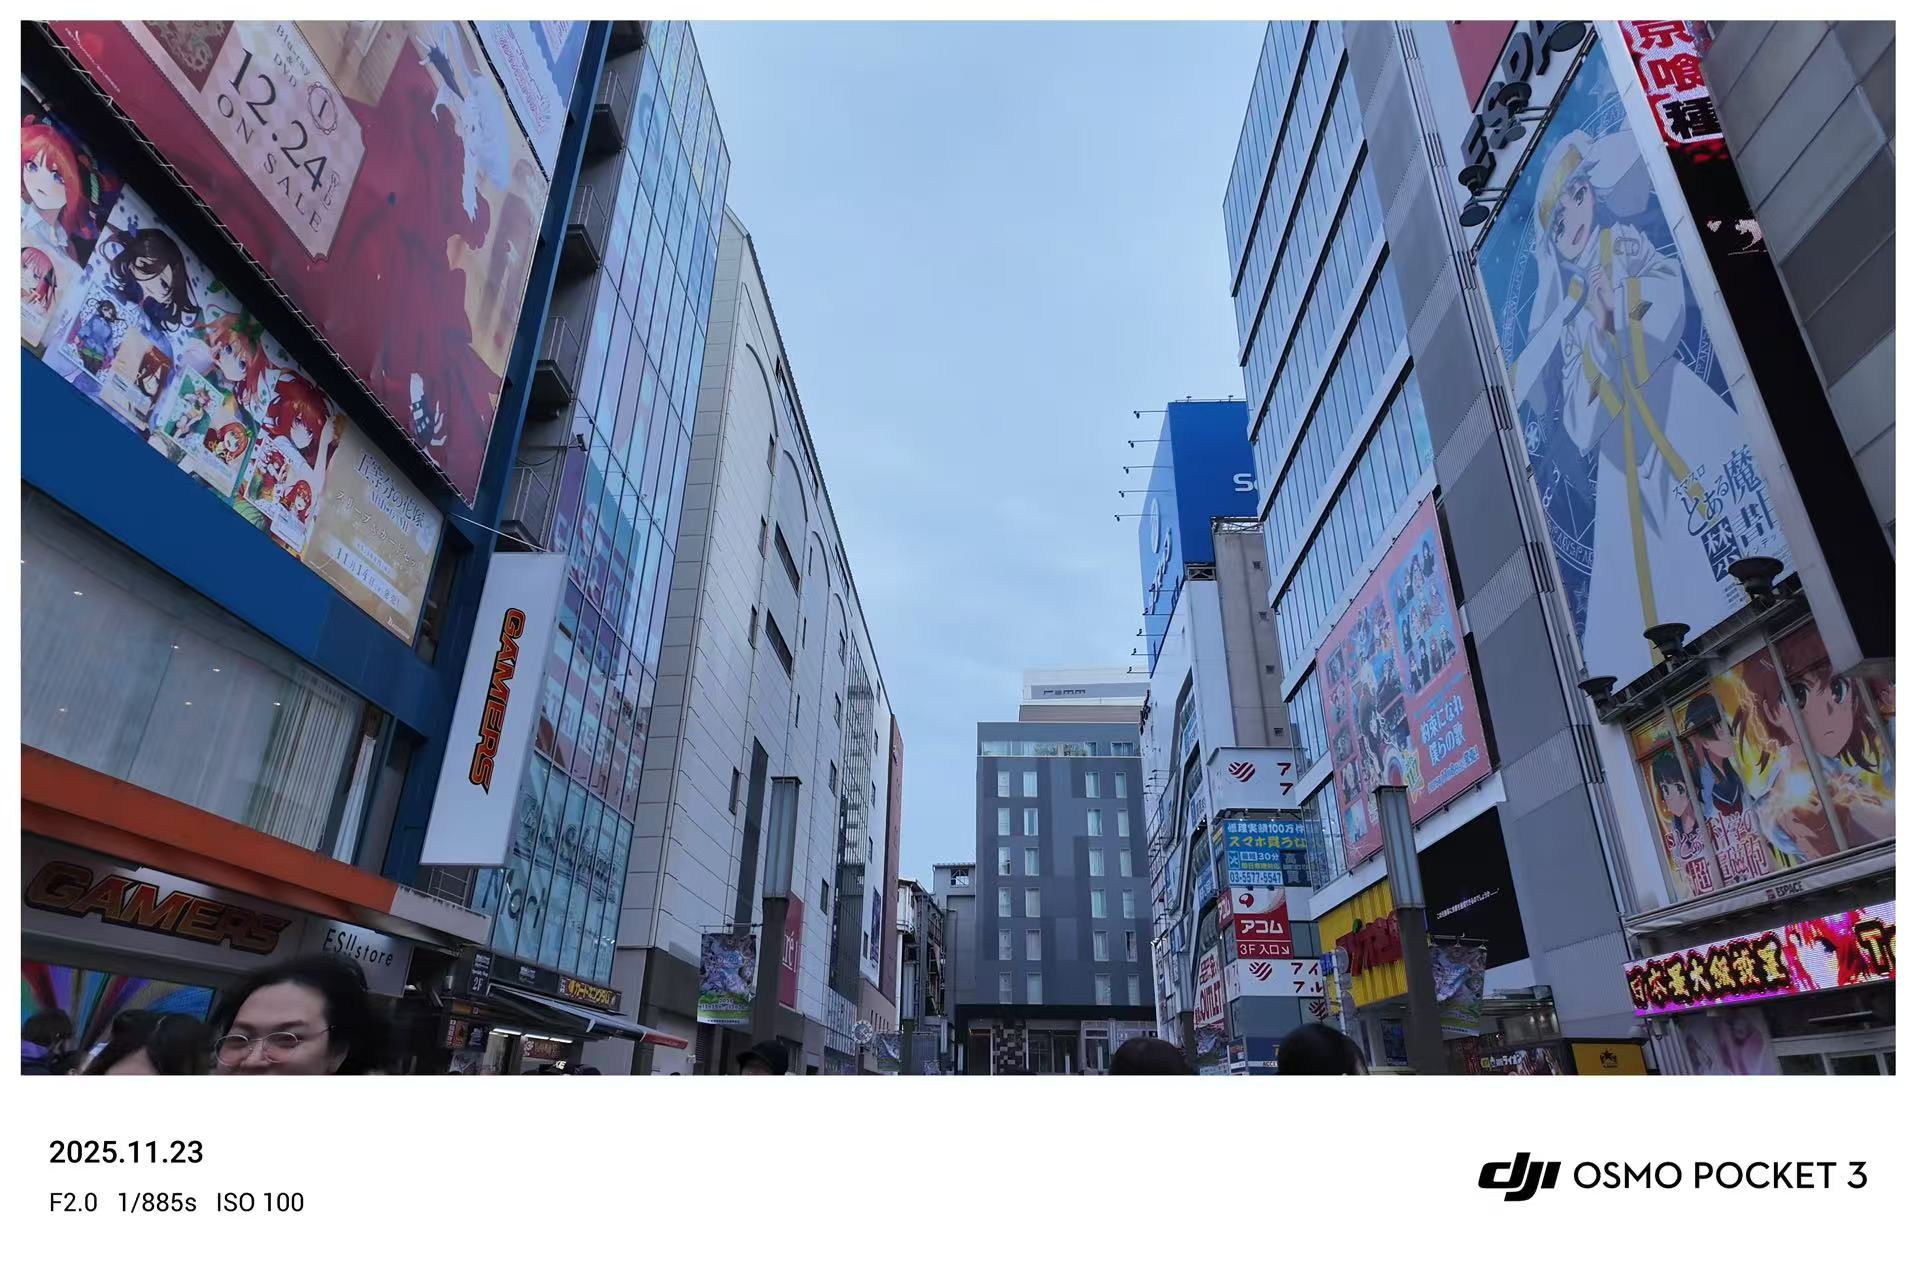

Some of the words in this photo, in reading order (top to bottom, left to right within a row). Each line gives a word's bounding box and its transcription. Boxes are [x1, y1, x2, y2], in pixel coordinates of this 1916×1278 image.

[273, 53, 297, 88] DVD
[229, 48, 327, 192] 12.24
[217, 94, 254, 145] ON
[263, 153, 322, 233] SALE
[1233, 473, 1258, 492] S
[469, 607, 526, 795] GAMERS
[1230, 871, 1282, 884] 03-5577-5547
[1776, 884, 1804, 899] ESPACE
[25, 860, 294, 956] GAMERS
[1241, 920, 1284, 934] アコム
[1239, 944, 1256, 955] 3F
[1259, 944, 1279, 954] 入口
[473, 976, 483, 992] 2F
